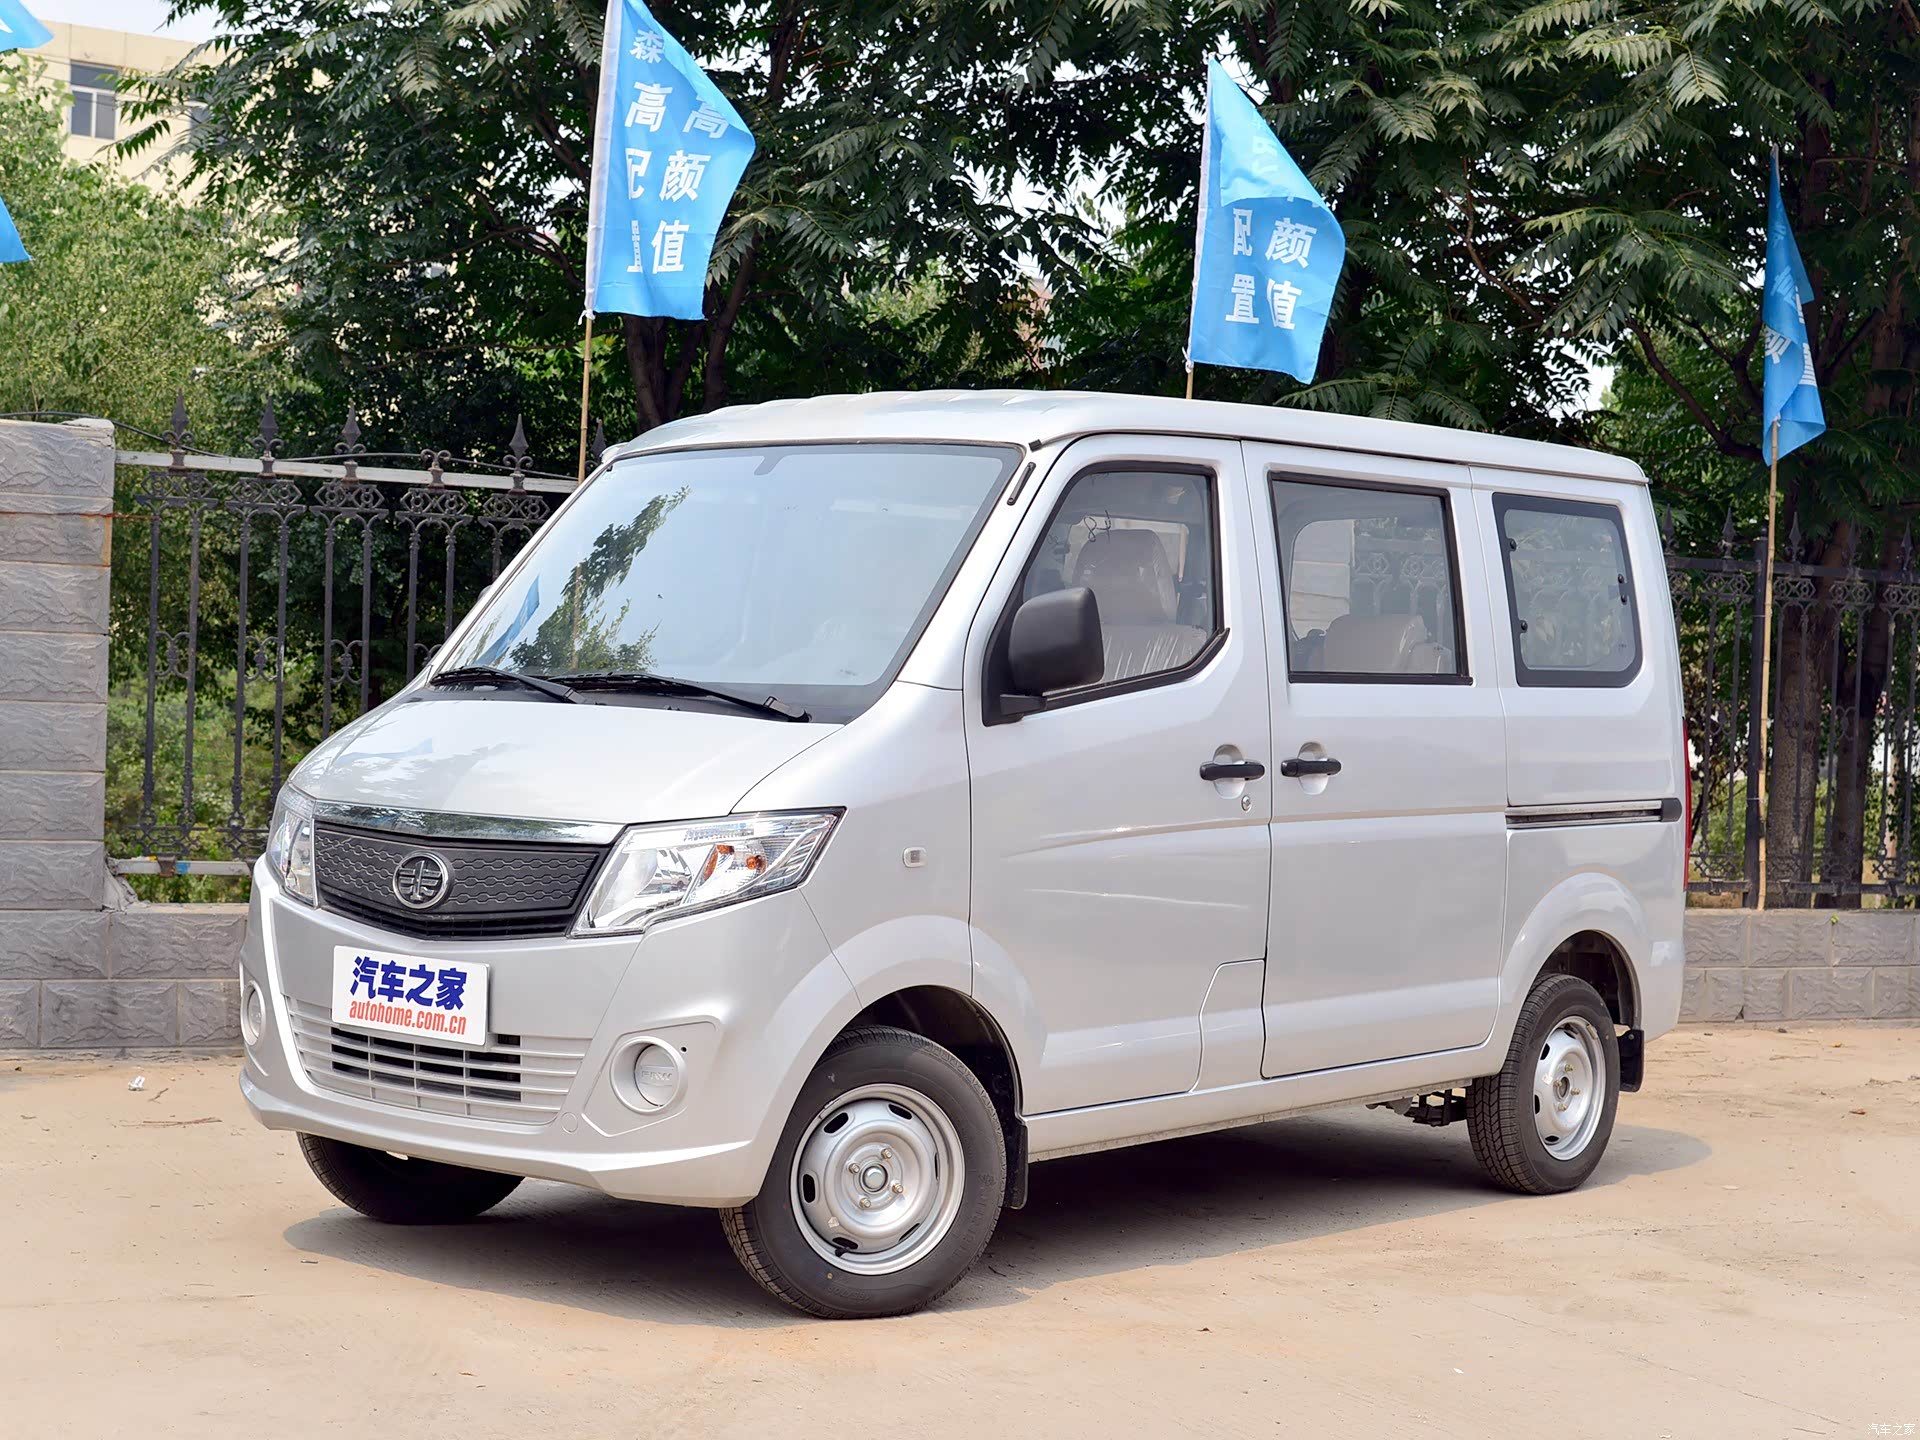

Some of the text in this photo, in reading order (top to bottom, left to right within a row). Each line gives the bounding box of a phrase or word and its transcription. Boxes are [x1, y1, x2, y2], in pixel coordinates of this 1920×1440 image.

[629, 28, 664, 64] 森
[349, 955, 468, 1011] 汽车之家
[349, 999, 467, 1036] autohome.com.cn
